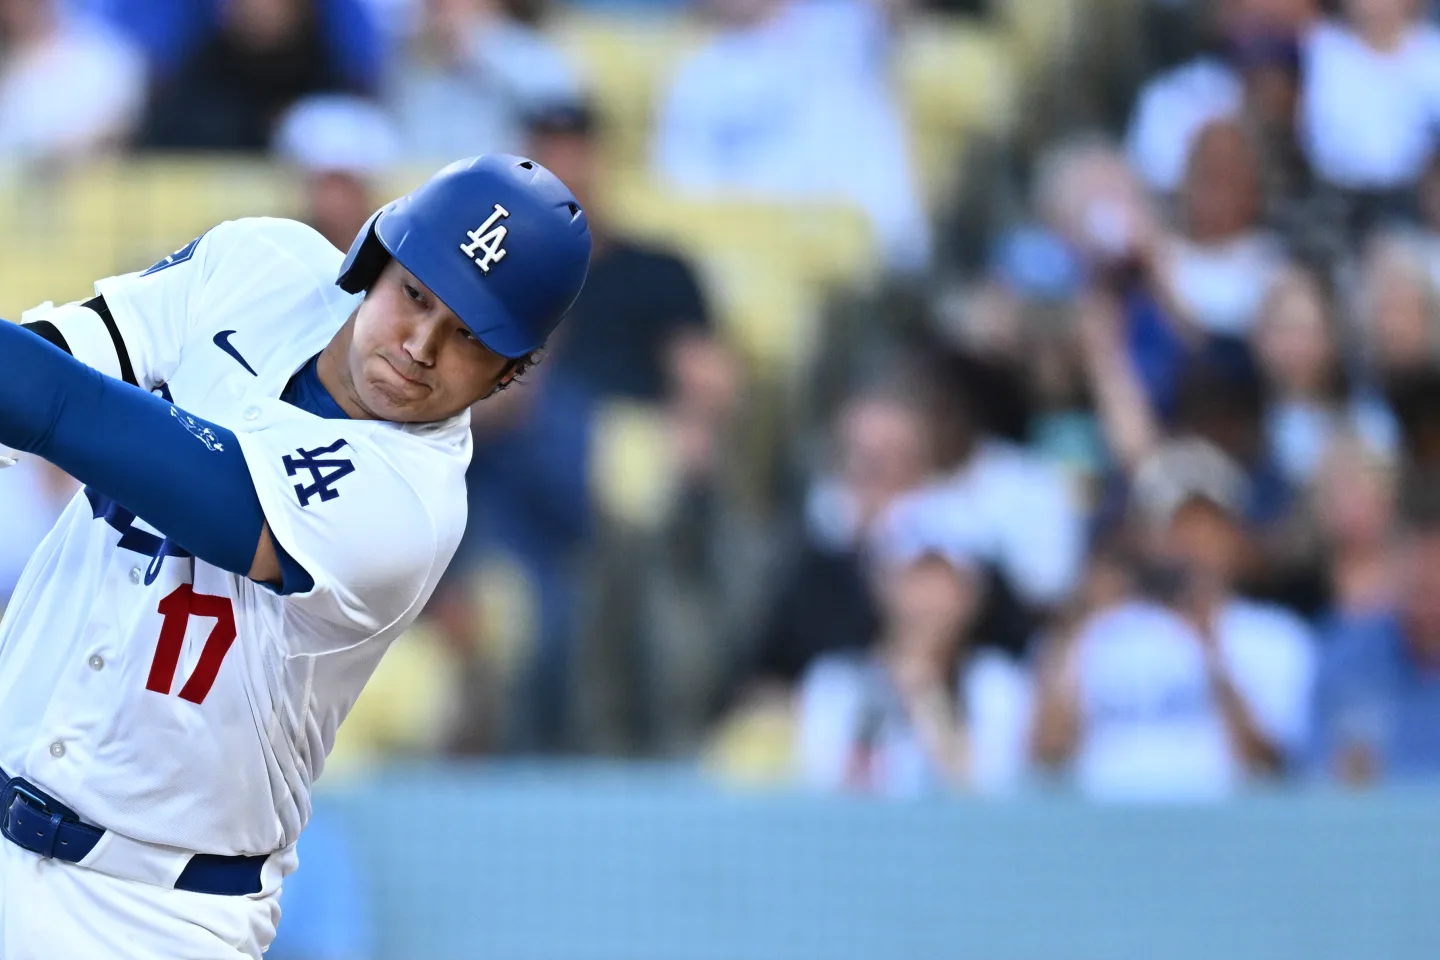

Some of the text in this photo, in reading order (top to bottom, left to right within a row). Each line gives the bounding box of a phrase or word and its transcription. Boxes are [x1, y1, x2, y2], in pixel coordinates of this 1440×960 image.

[459, 203, 511, 273] LA
[281, 437, 356, 508] LA
[145, 582, 237, 705] 17
